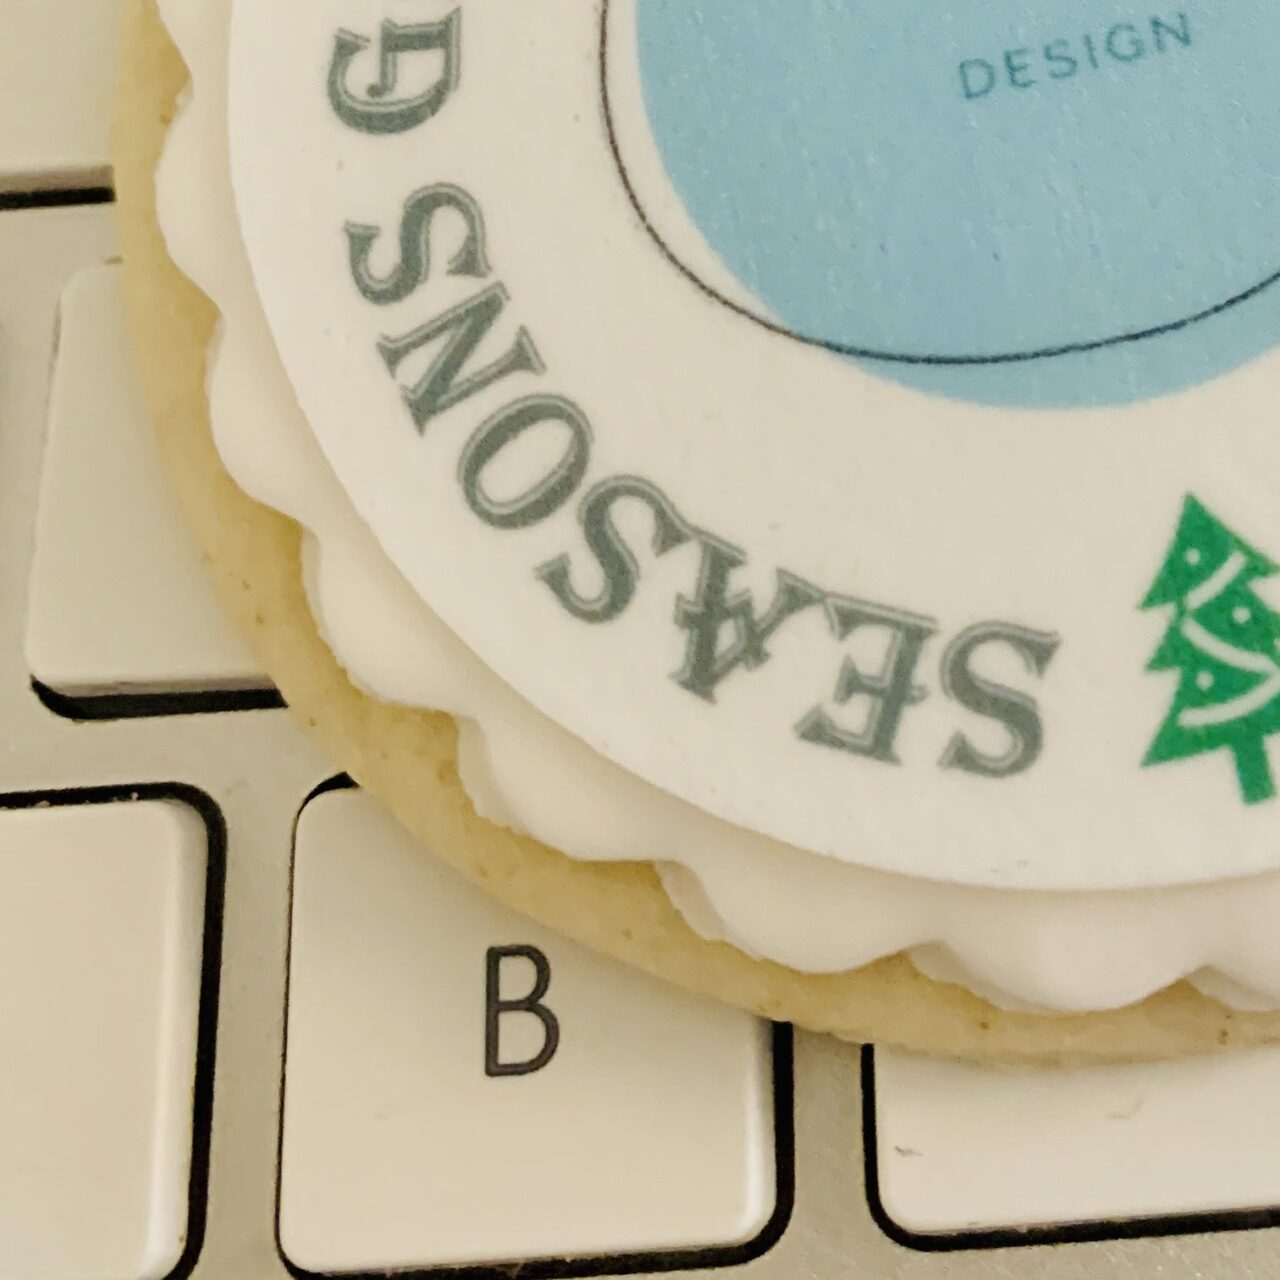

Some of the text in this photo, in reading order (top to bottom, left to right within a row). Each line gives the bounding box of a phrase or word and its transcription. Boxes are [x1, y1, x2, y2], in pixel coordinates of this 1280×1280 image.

[956, 10, 1195, 102] DESIGN
[343, 181, 1062, 780] SEASONS
[484, 944, 561, 1078] B
